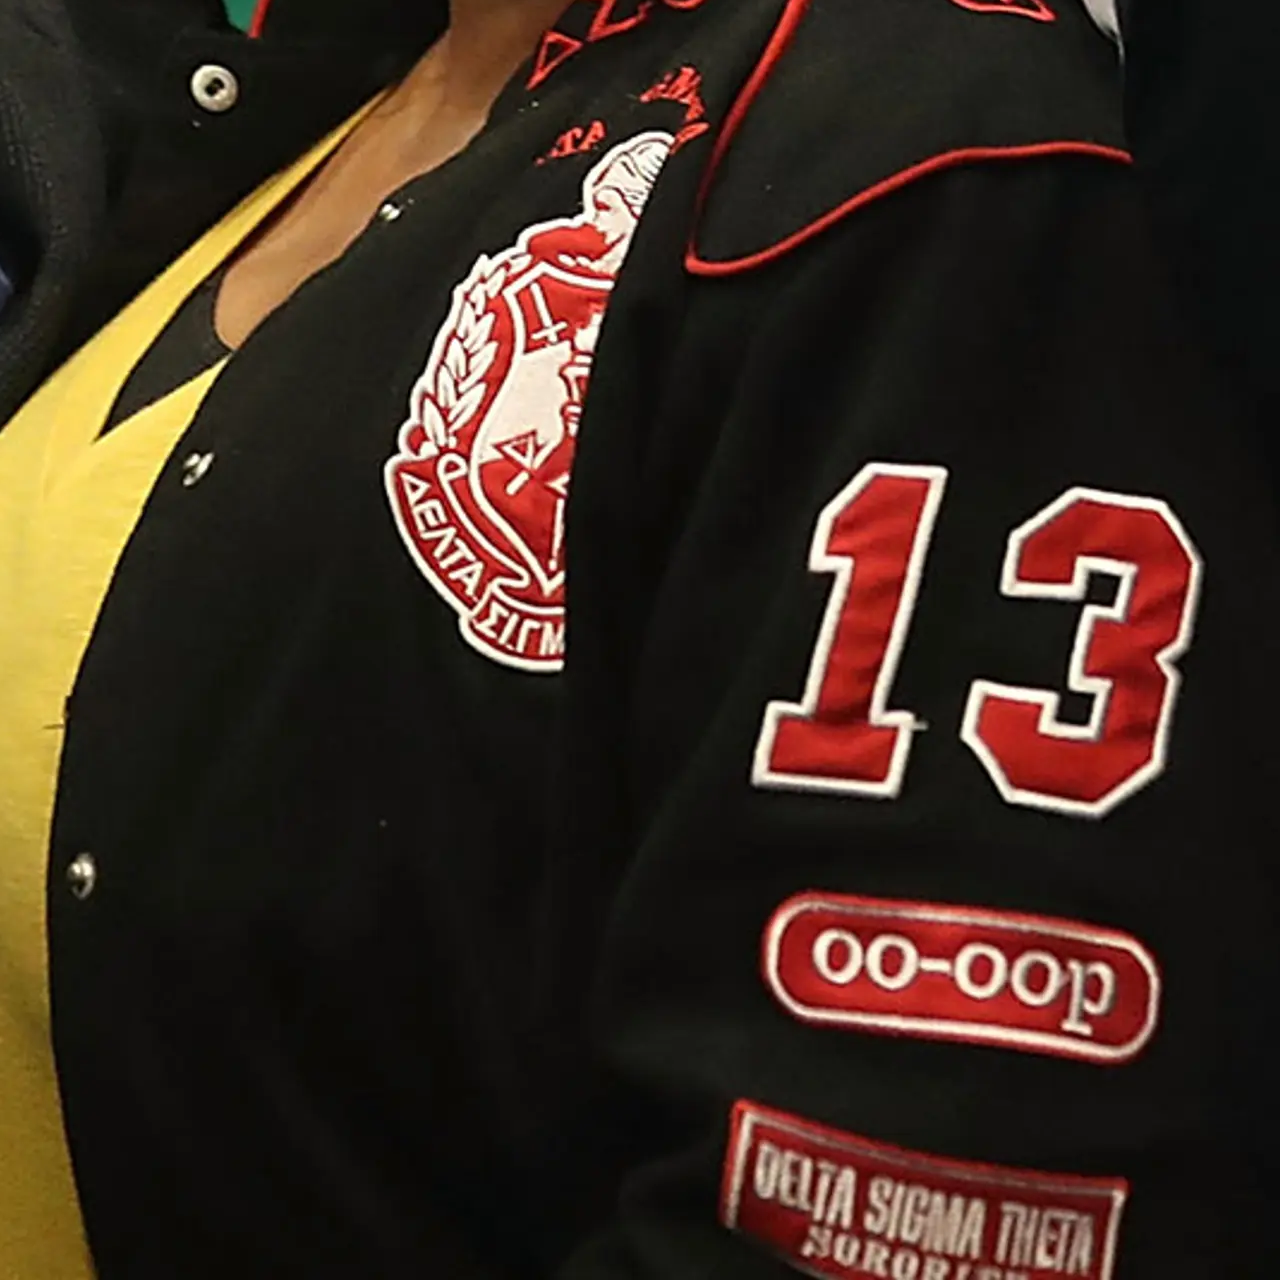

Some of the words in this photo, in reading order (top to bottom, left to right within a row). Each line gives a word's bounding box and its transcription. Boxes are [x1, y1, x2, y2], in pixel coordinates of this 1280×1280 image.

[751, 461, 1204, 818] 13
[812, 928, 1116, 1036] oo-oop
[753, 1141, 857, 1230] DELTA
[863, 1176, 987, 1261] SIGMA
[995, 1201, 1096, 1276] THETA
